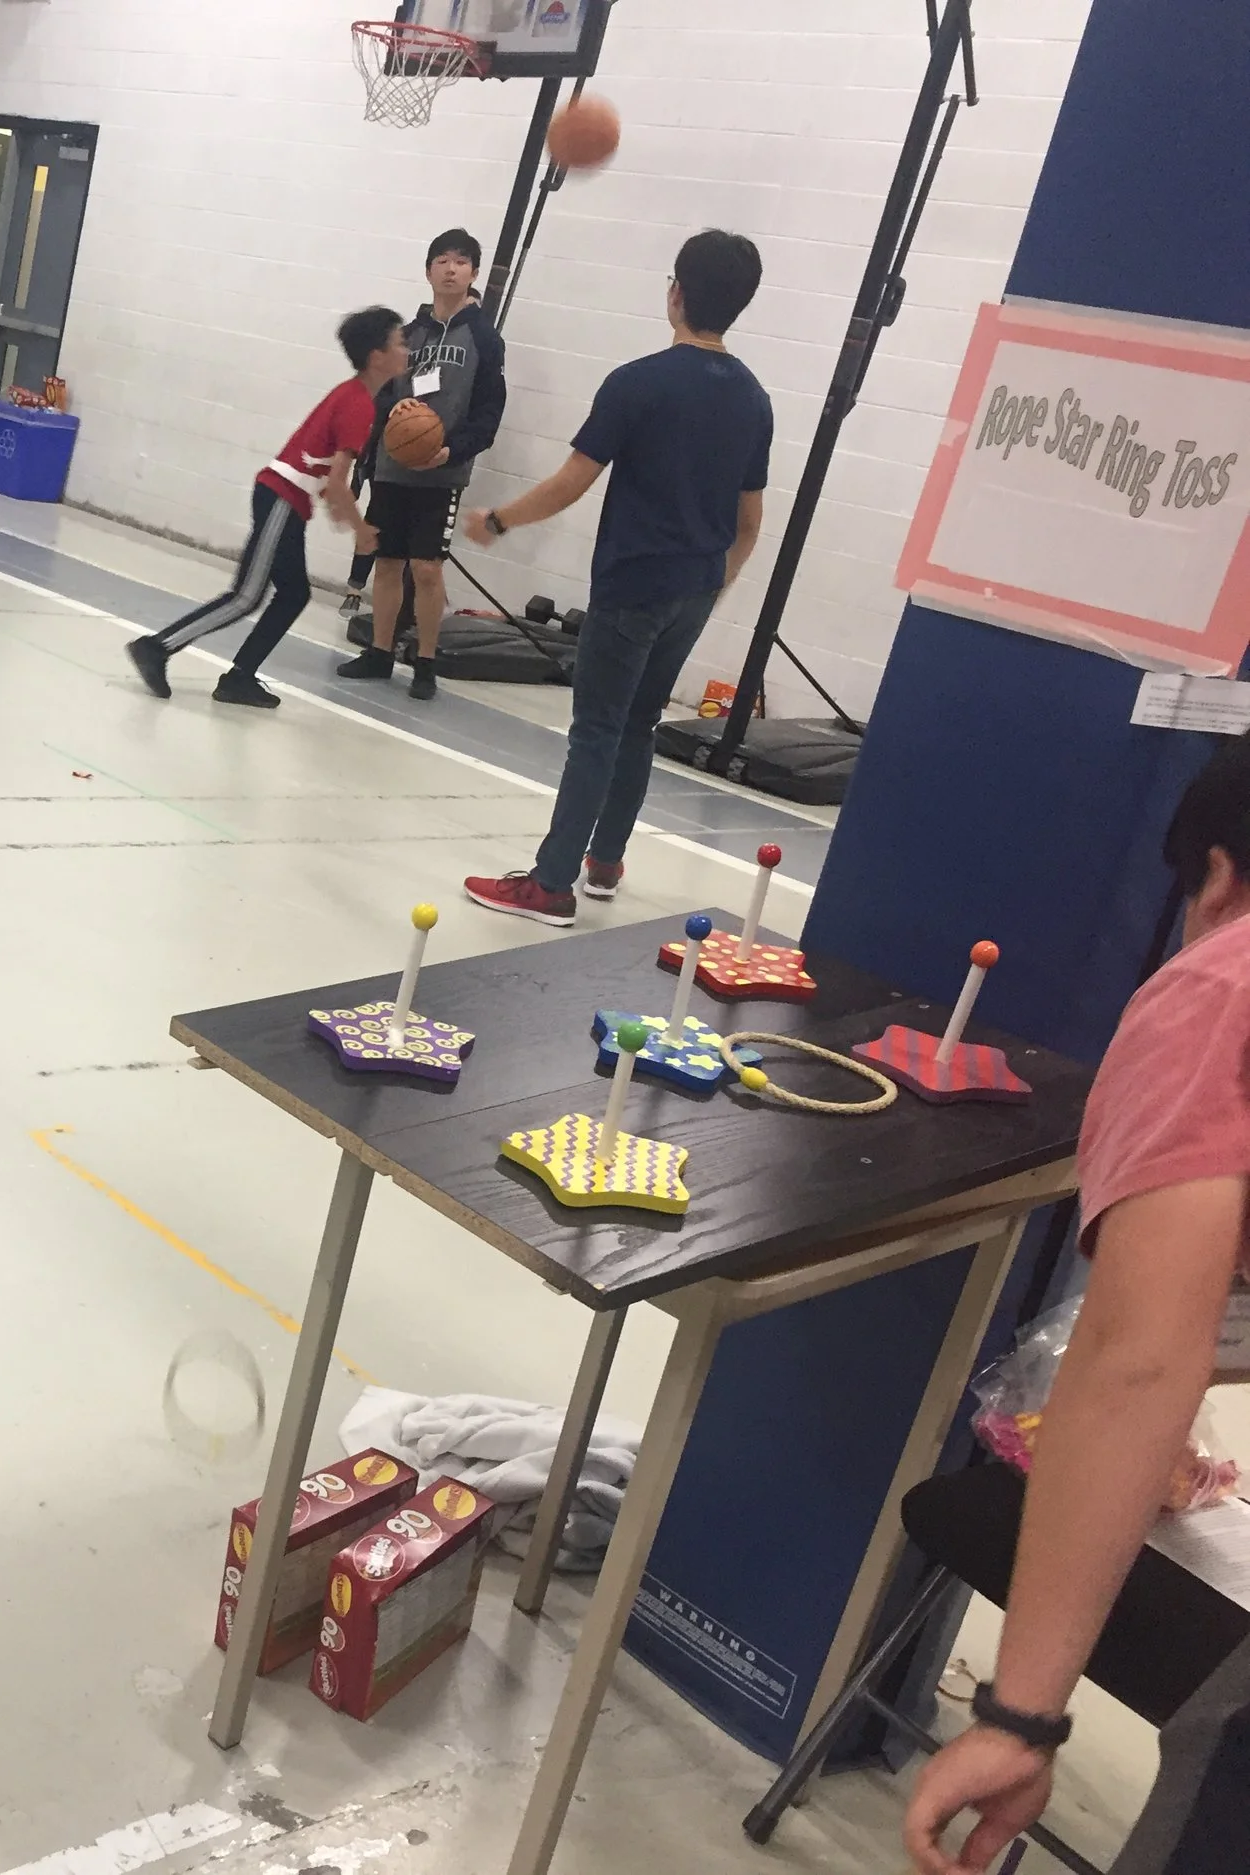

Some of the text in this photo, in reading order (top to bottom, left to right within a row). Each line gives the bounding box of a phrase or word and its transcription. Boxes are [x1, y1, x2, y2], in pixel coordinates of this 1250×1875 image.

[975, 385, 1239, 518] Rope Star Ring Toss
[300, 1473, 347, 1499] 90
[386, 1509, 432, 1539] 90
[320, 1616, 339, 1649] 90
[659, 1588, 756, 1662] WARNING
